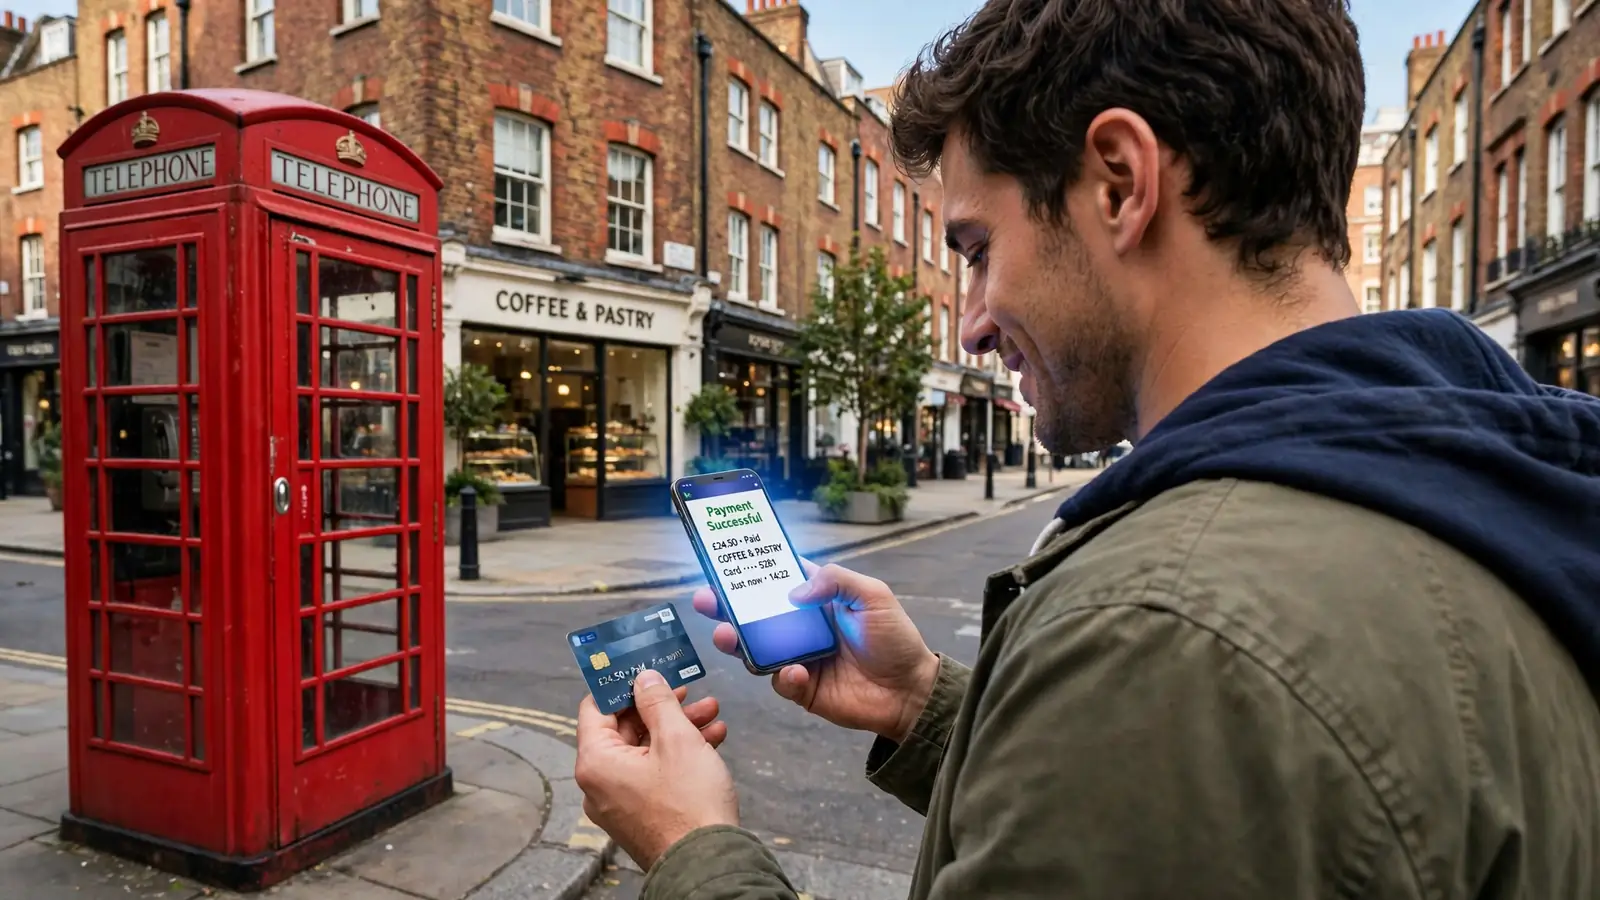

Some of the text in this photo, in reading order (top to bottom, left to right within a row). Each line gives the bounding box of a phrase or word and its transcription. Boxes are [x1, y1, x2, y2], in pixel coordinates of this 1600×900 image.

[88, 148, 214, 194] TELEPHONE
[276, 154, 414, 221] TELEPHONE
[496, 289, 655, 329] COFFEE & PASTRY
[706, 501, 754, 517] Payment
[707, 512, 763, 531] Successful
[712, 534, 761, 551] £24.50 Paid
[717, 543, 783, 564] COFFEE & PASTRY
[723, 565, 742, 577] Card
[730, 569, 790, 590] Just now 14:22
